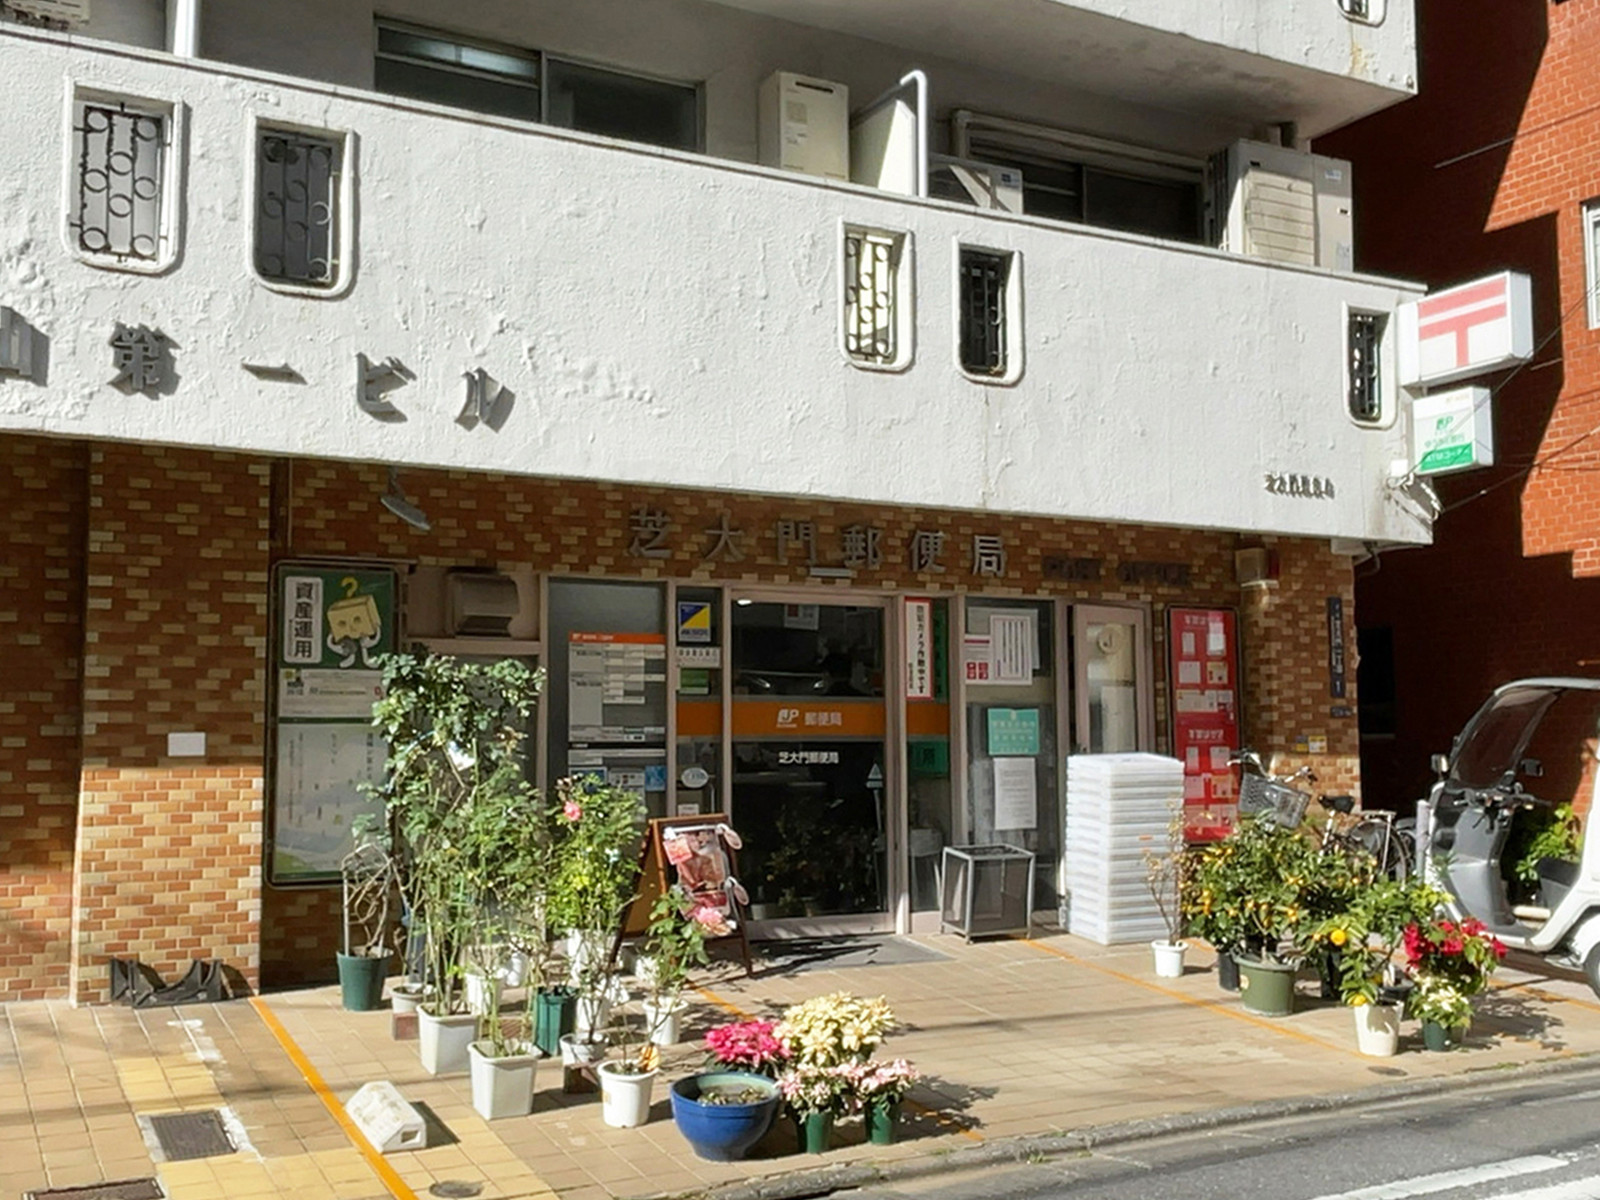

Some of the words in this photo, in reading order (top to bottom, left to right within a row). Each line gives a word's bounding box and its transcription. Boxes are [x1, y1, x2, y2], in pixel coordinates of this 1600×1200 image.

[628, 505, 1006, 578] 芝大門郵便局
[294, 582, 313, 658] 資産運用
[804, 711, 843, 727] 郵便局
[778, 750, 840, 765] 芝大門郵便局
